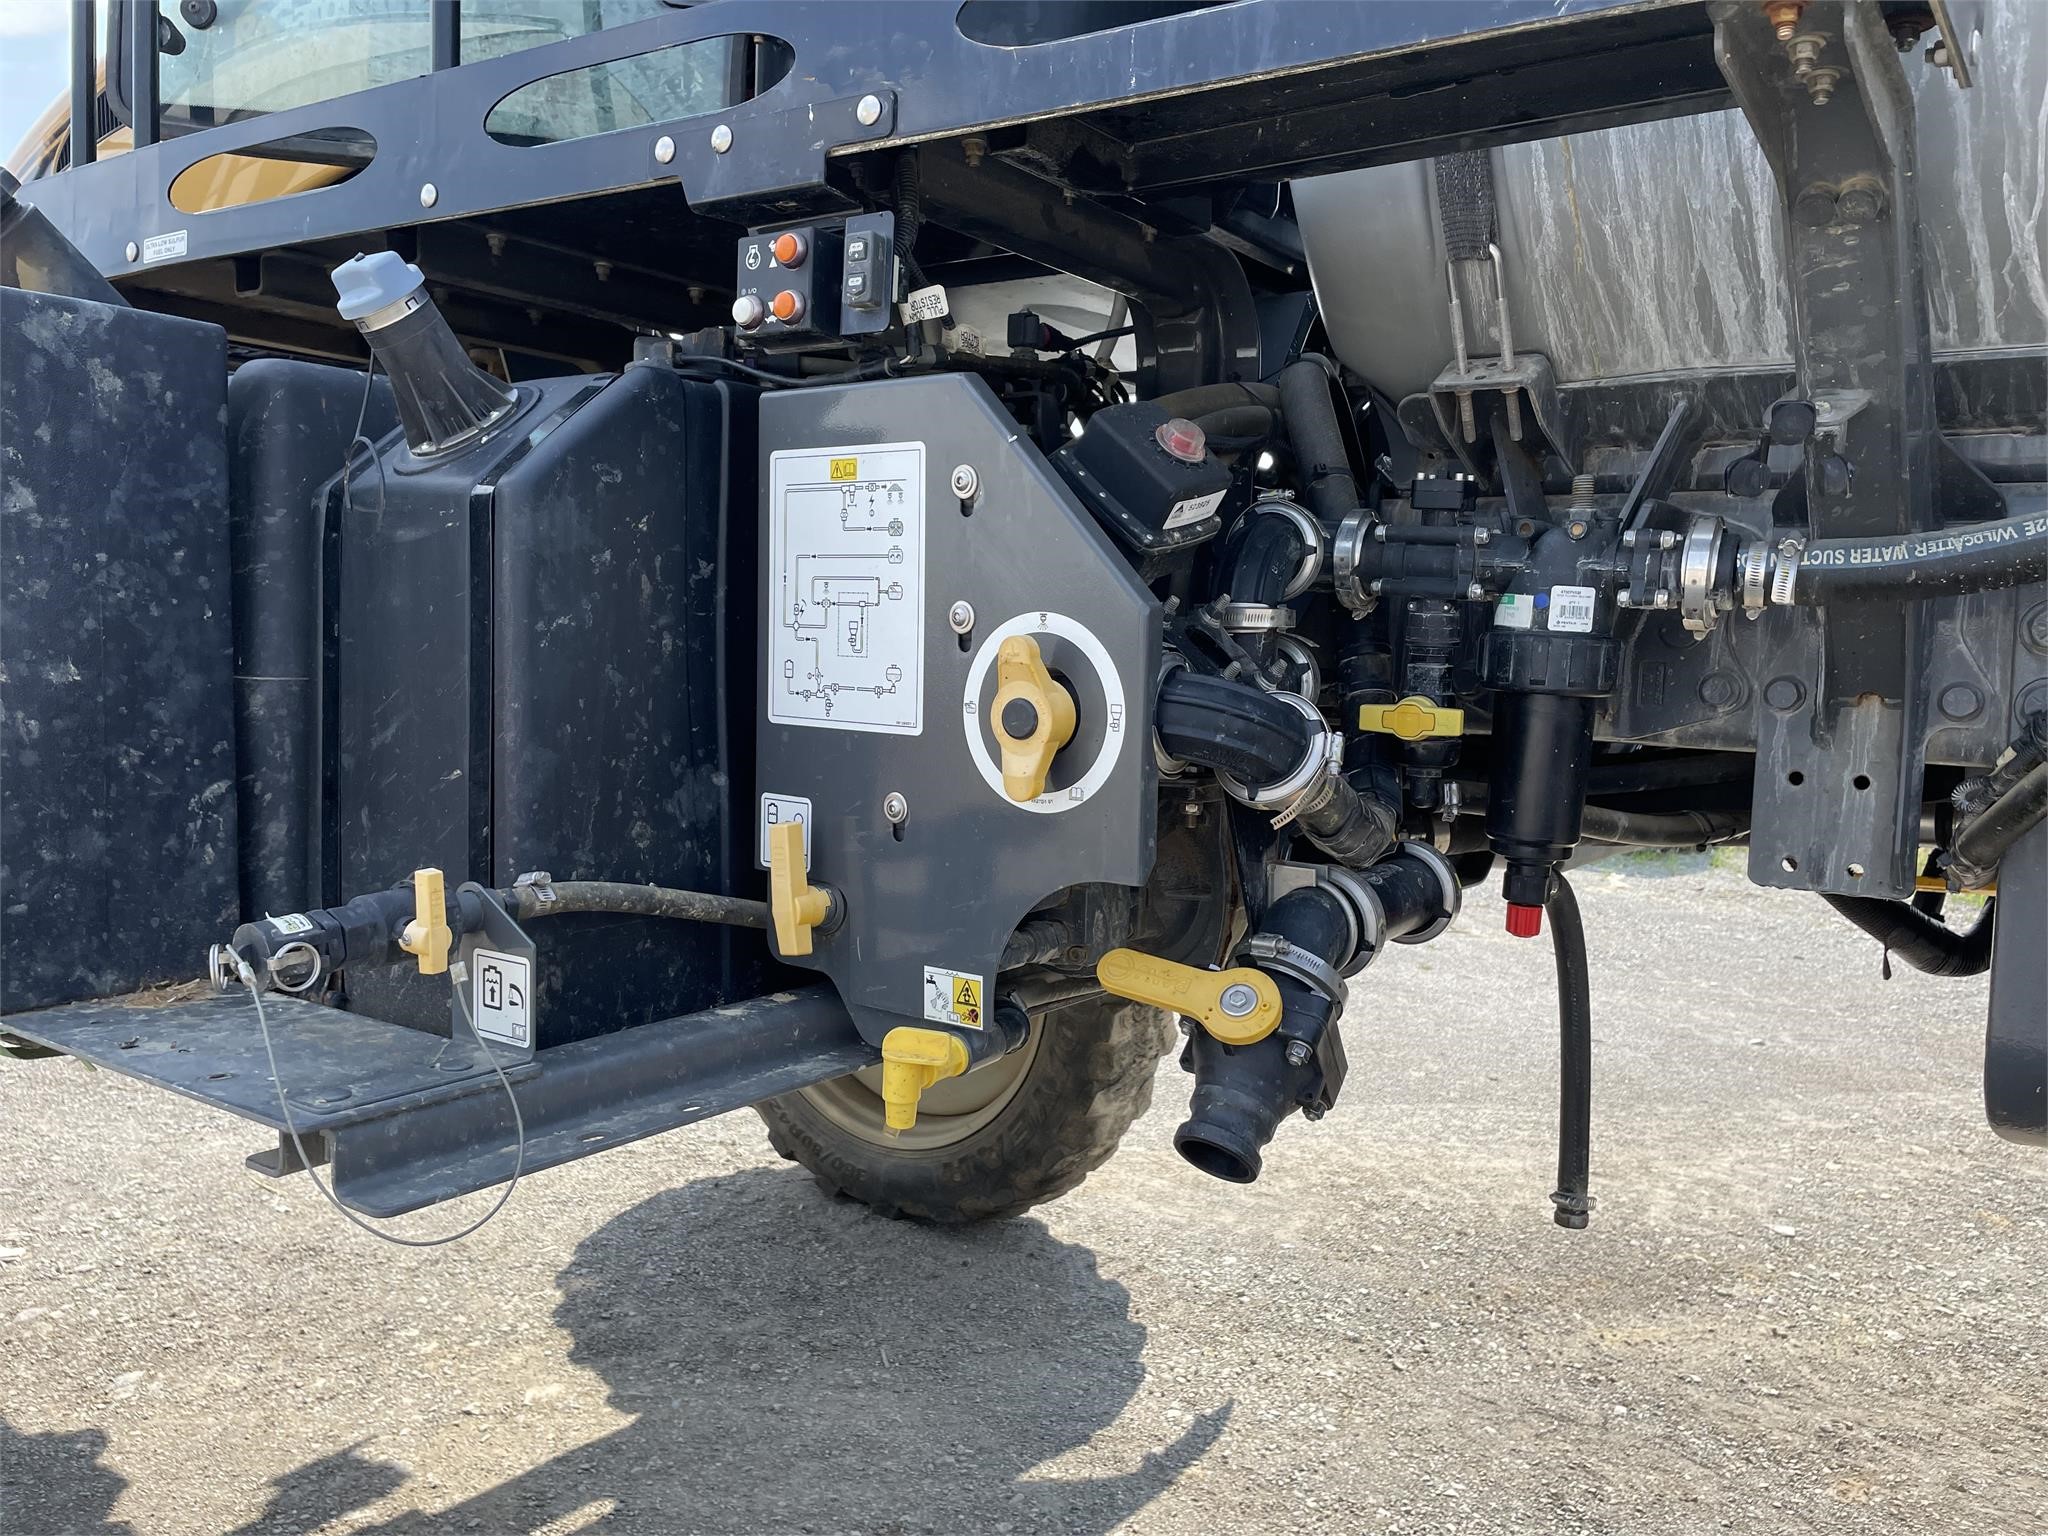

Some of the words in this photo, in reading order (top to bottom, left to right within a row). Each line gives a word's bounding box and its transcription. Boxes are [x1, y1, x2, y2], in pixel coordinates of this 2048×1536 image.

[909, 293, 942, 312] RESISTOR
[927, 304, 944, 317] PULL
[1850, 542, 1909, 564] WATER
